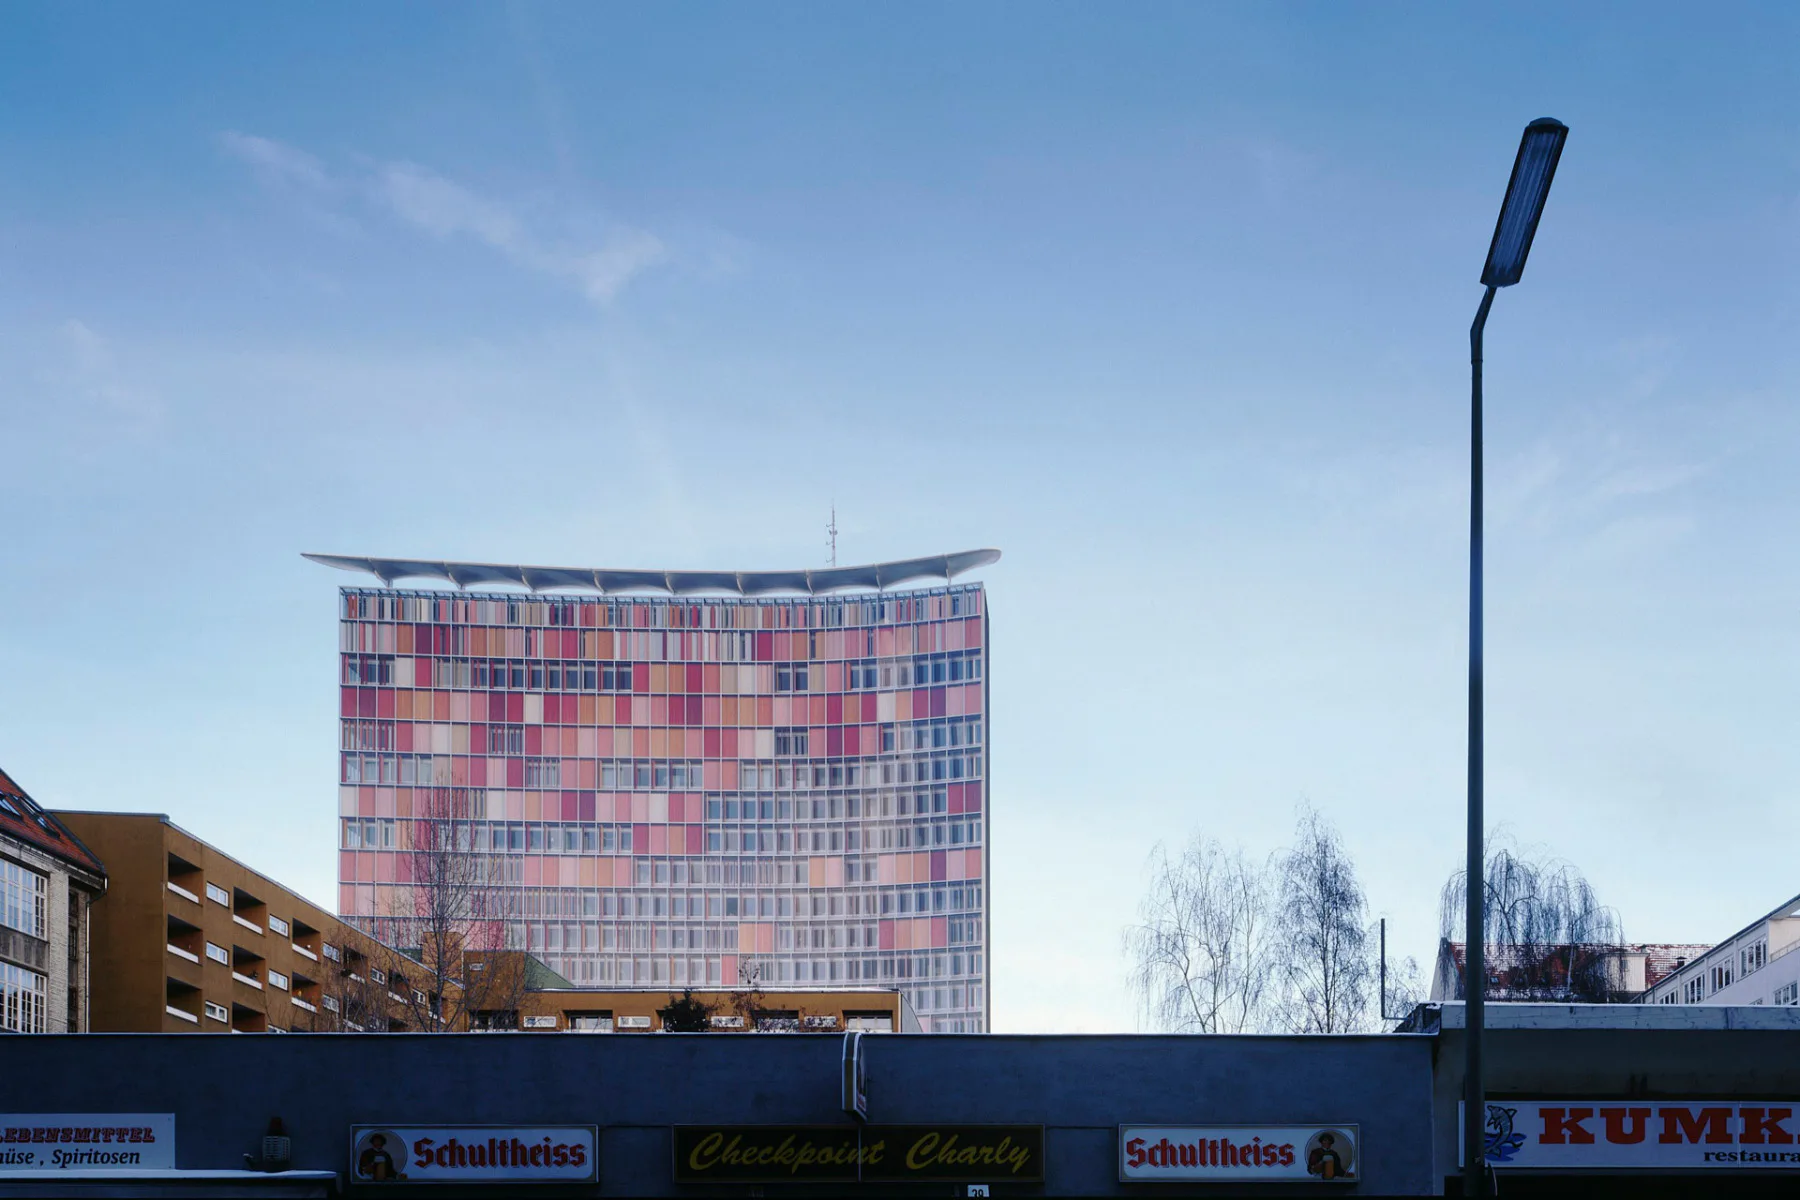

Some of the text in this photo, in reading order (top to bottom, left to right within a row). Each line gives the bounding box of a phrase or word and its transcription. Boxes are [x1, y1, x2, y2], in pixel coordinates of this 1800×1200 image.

[0, 1127, 155, 1143] EBENSMITTEL
[1538, 1107, 1800, 1144] KUMK
[51, 1149, 140, 1168] Spiritosen
[413, 1136, 588, 1169] Schultheiss
[689, 1132, 1031, 1174] Checkpoint Charly
[1126, 1136, 1296, 1168] Schultheiss
